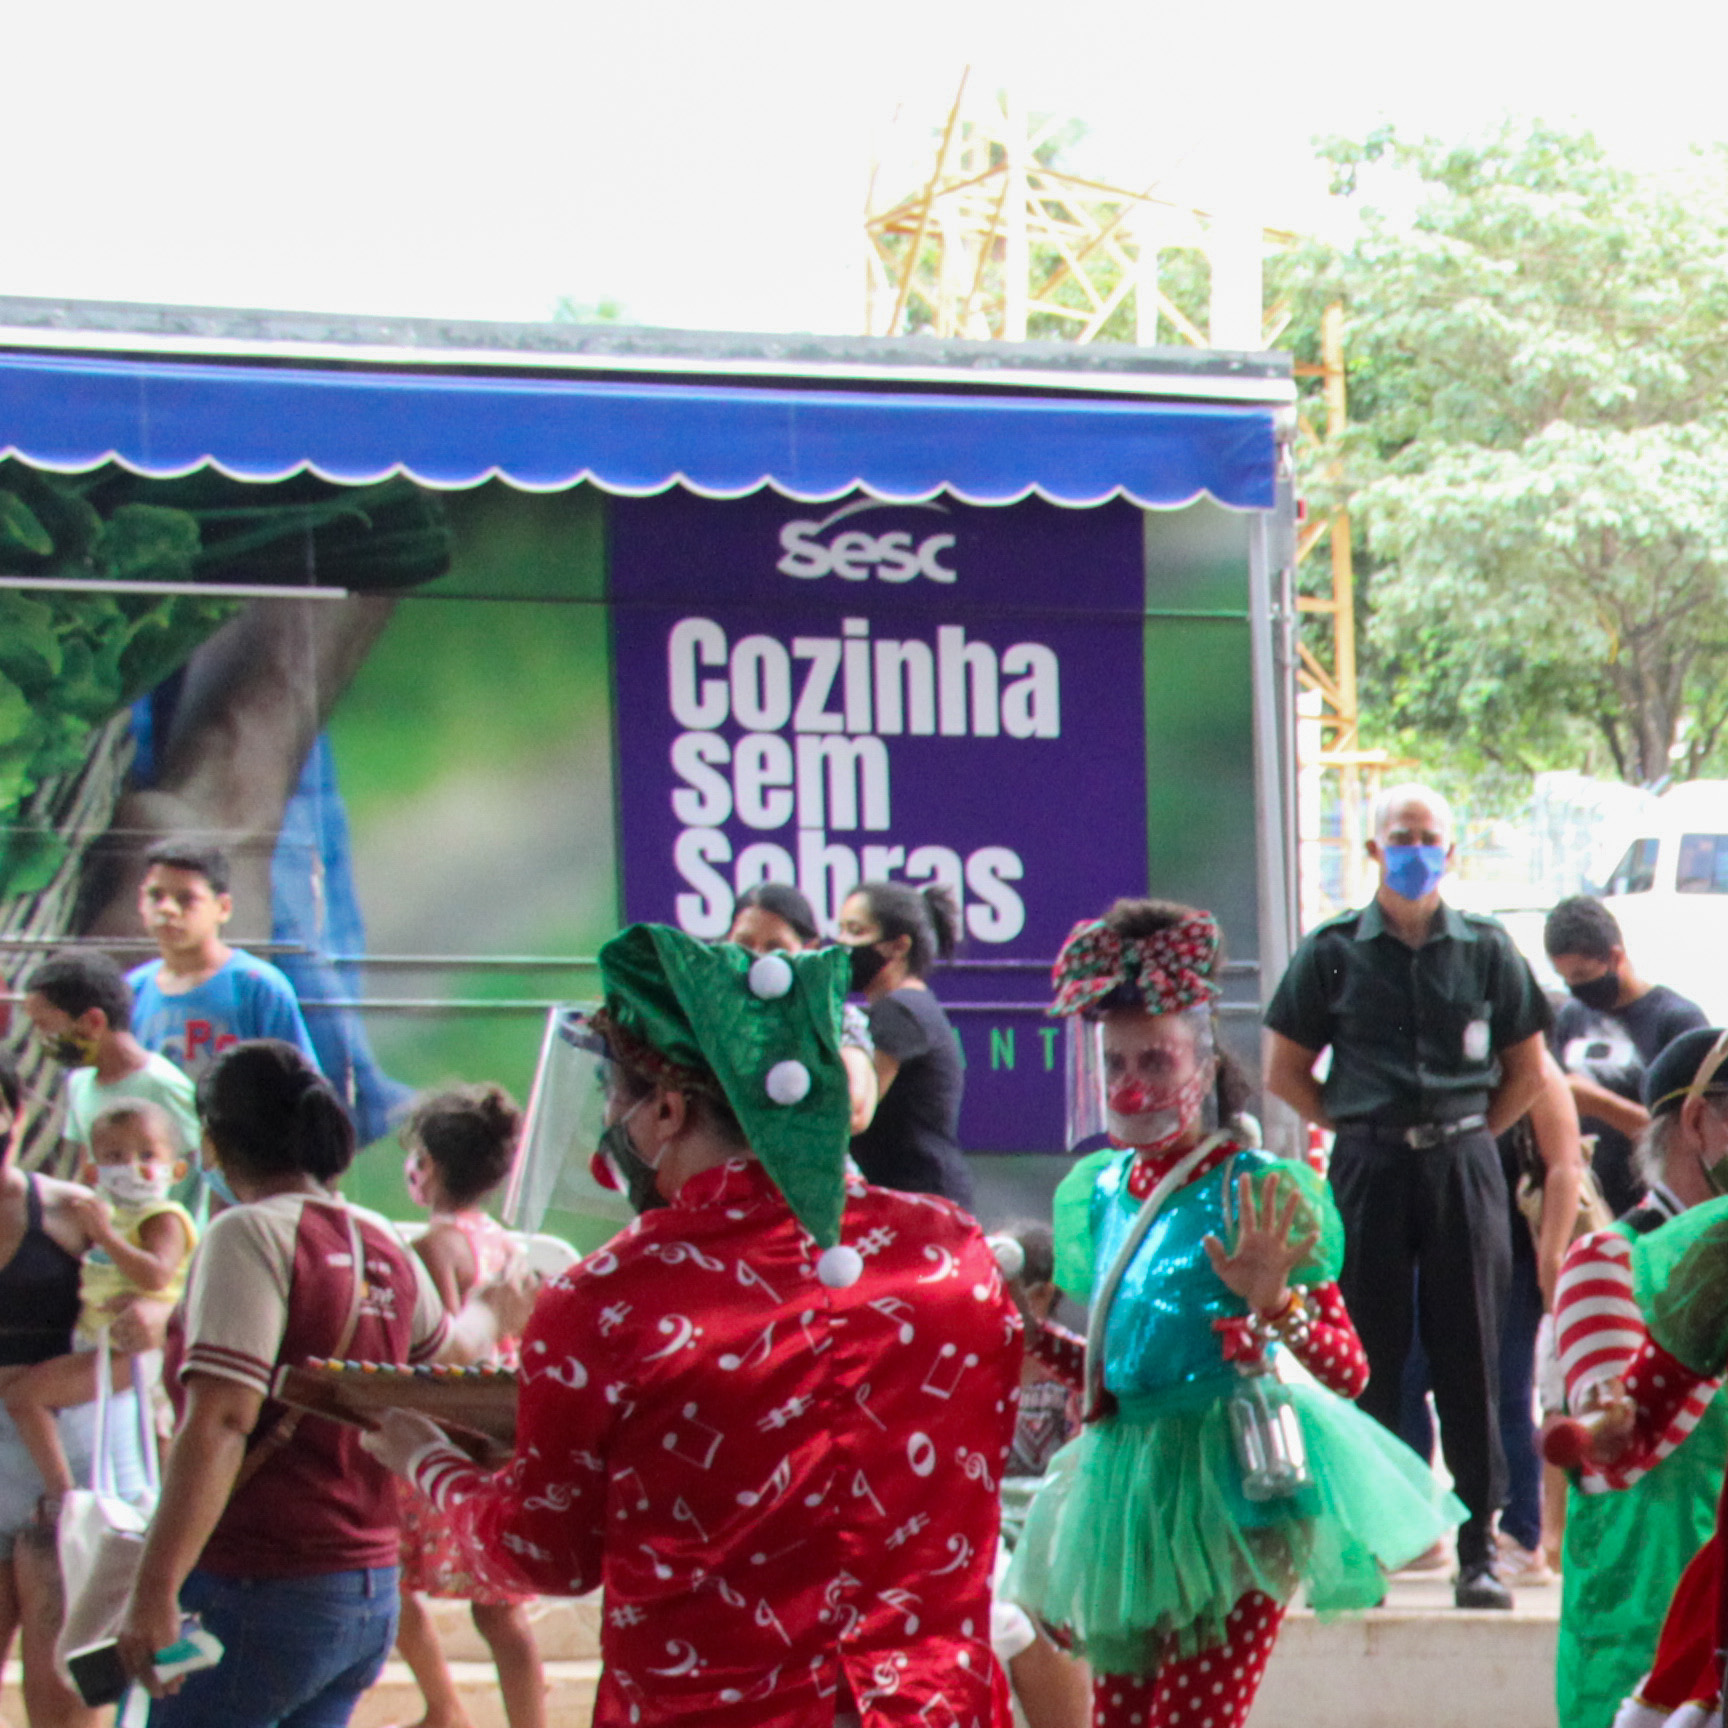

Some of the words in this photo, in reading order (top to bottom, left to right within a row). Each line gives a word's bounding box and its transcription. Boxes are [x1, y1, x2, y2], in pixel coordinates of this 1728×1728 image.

[776, 518, 957, 584] Sesc
[668, 617, 1060, 739] Cozinha
[671, 731, 891, 831] sem
